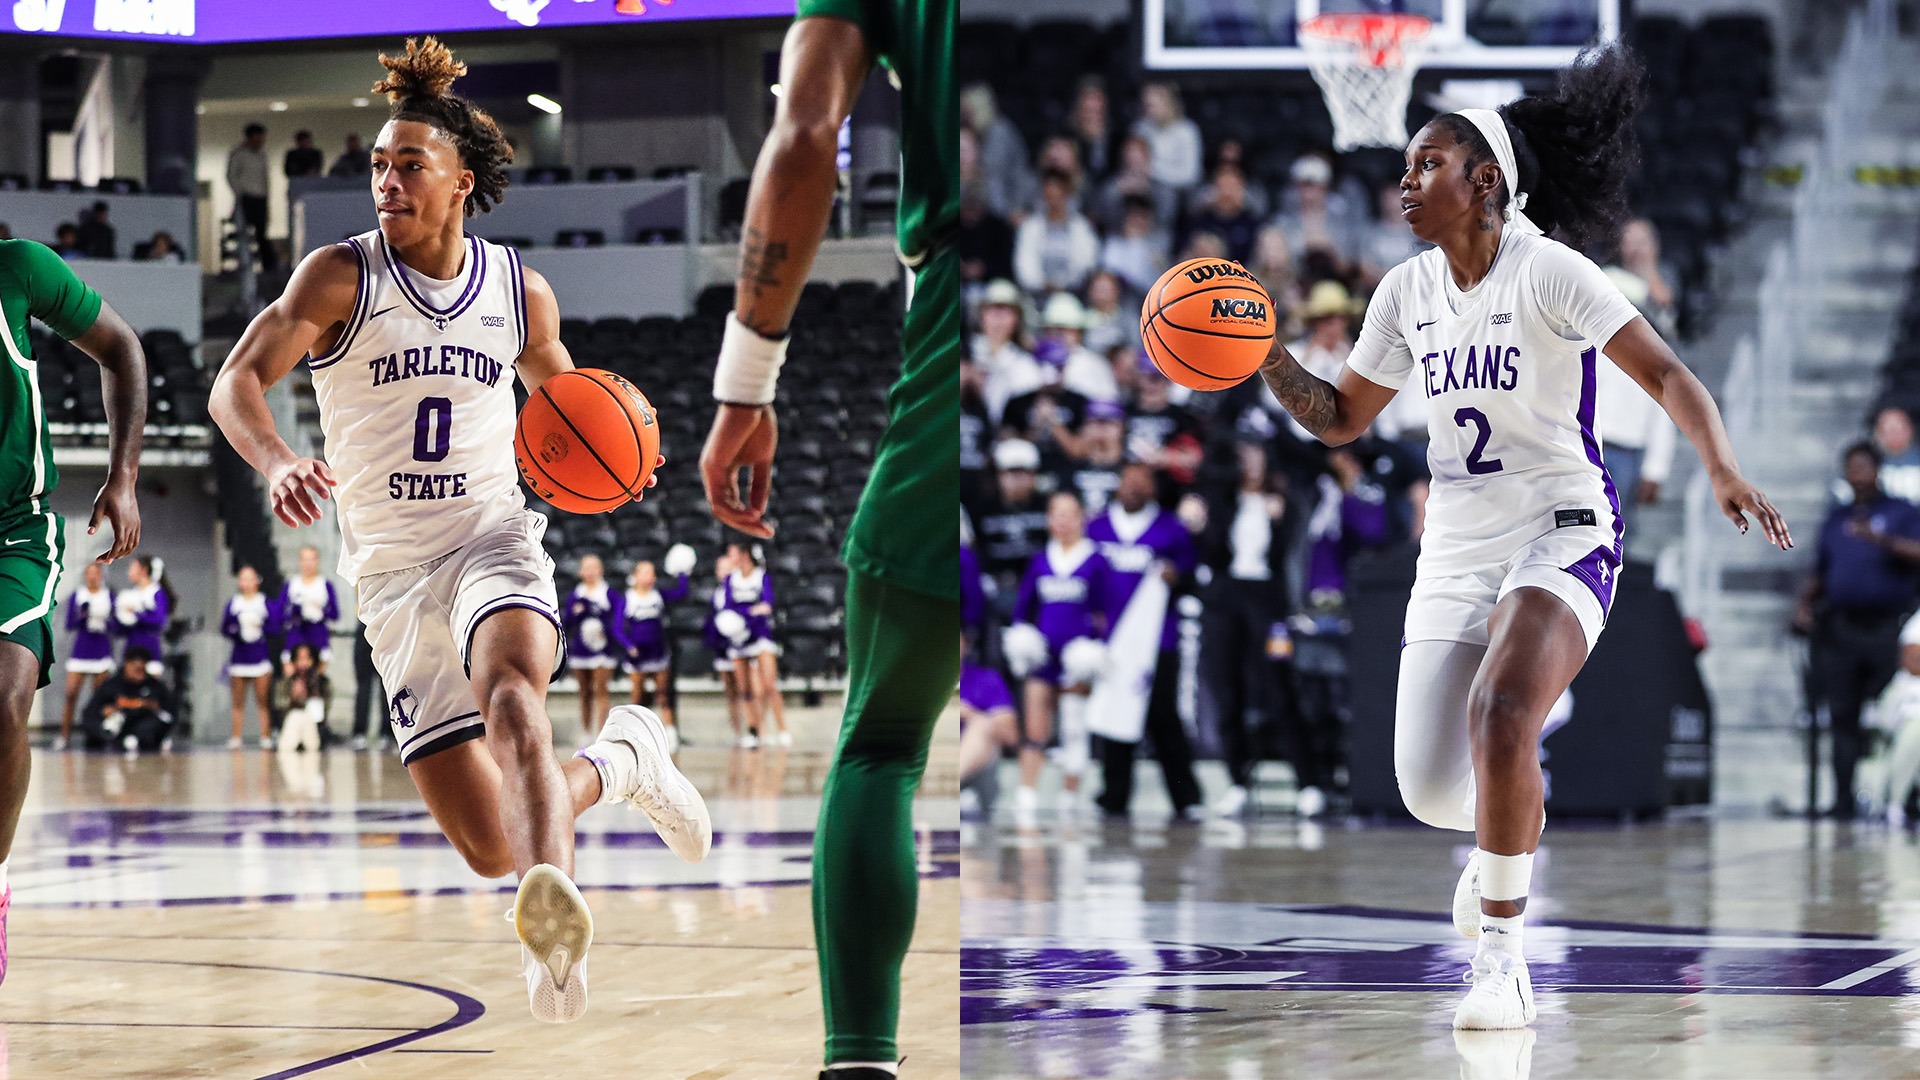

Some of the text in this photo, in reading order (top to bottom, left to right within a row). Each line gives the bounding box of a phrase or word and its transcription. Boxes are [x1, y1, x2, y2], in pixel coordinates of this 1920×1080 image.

[480, 316, 505, 328] WAC
[1210, 298, 1267, 322] NCAA
[1490, 312, 1513, 325] WAC
[369, 345, 504, 389] TARLETON
[1421, 345, 1521, 399] TEXANS
[602, 373, 655, 427] NCAA
[412, 396, 453, 463] 0
[1453, 406, 1504, 475] 2
[389, 473, 468, 501] STATE
